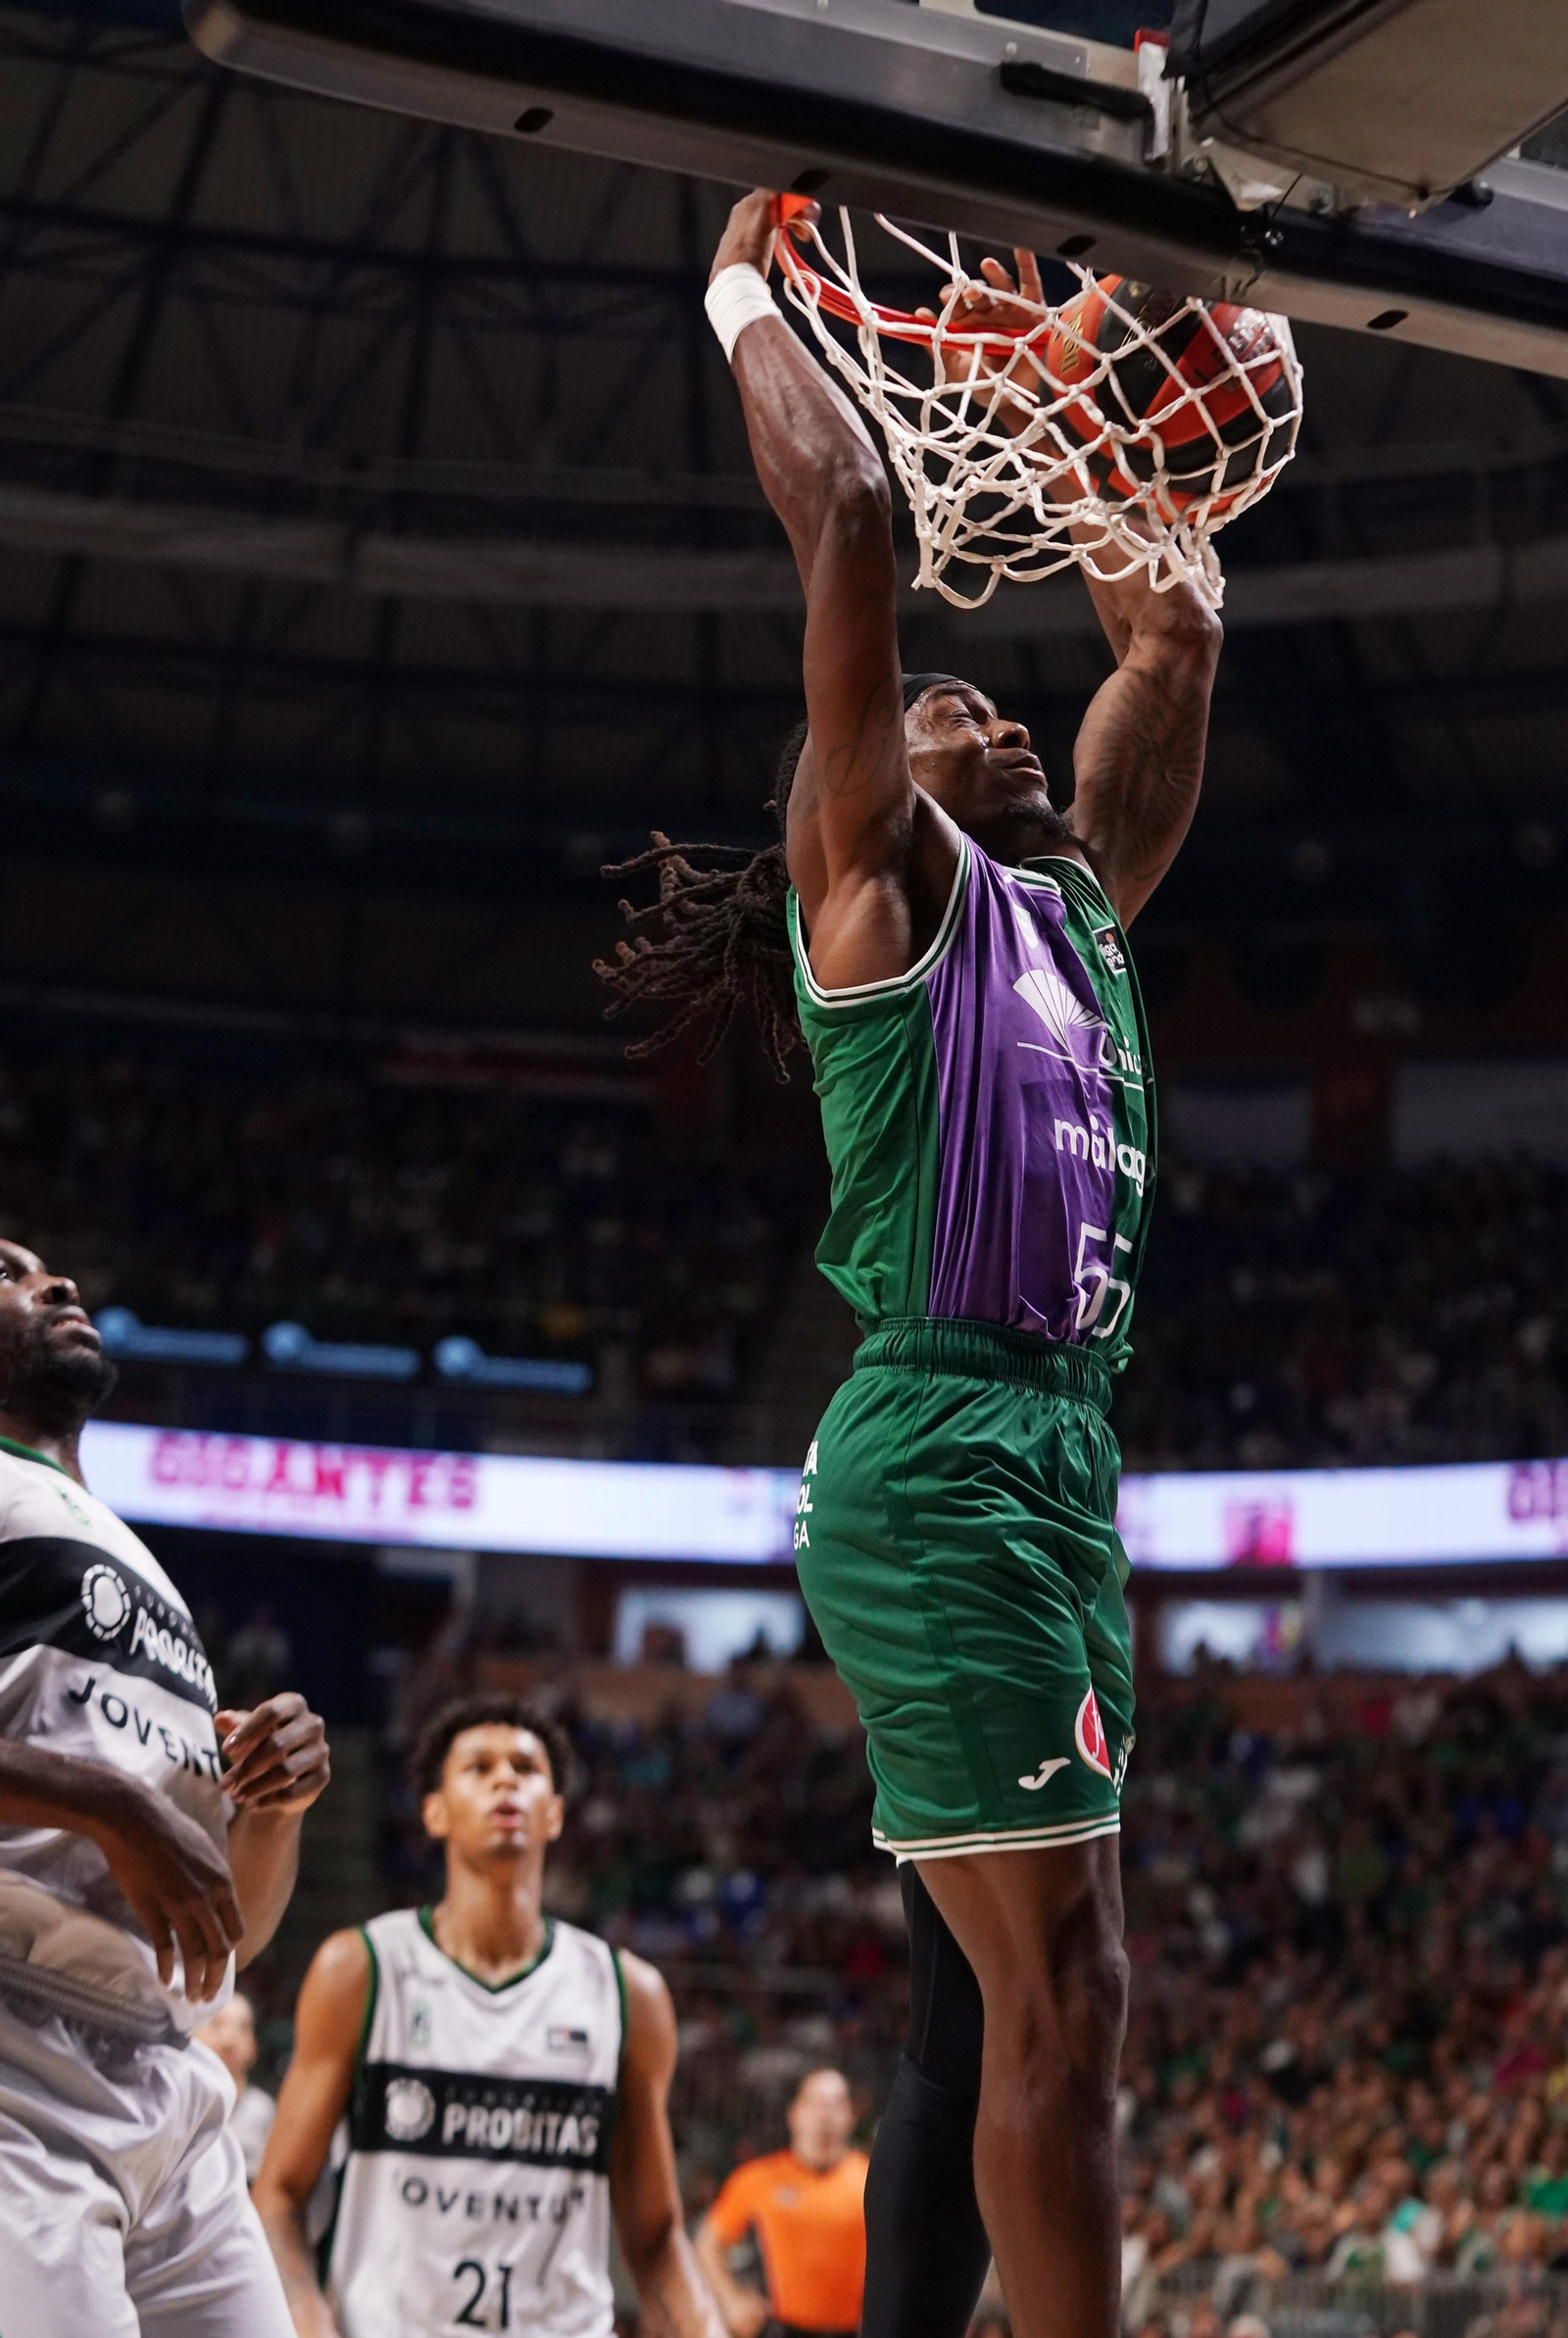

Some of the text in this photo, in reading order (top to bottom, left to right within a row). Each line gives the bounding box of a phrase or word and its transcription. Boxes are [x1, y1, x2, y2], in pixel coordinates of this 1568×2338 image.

[1074, 1221, 1134, 1339] 55
[442, 2103, 600, 2157] PROBITAS
[453, 2261, 513, 2329] 21
